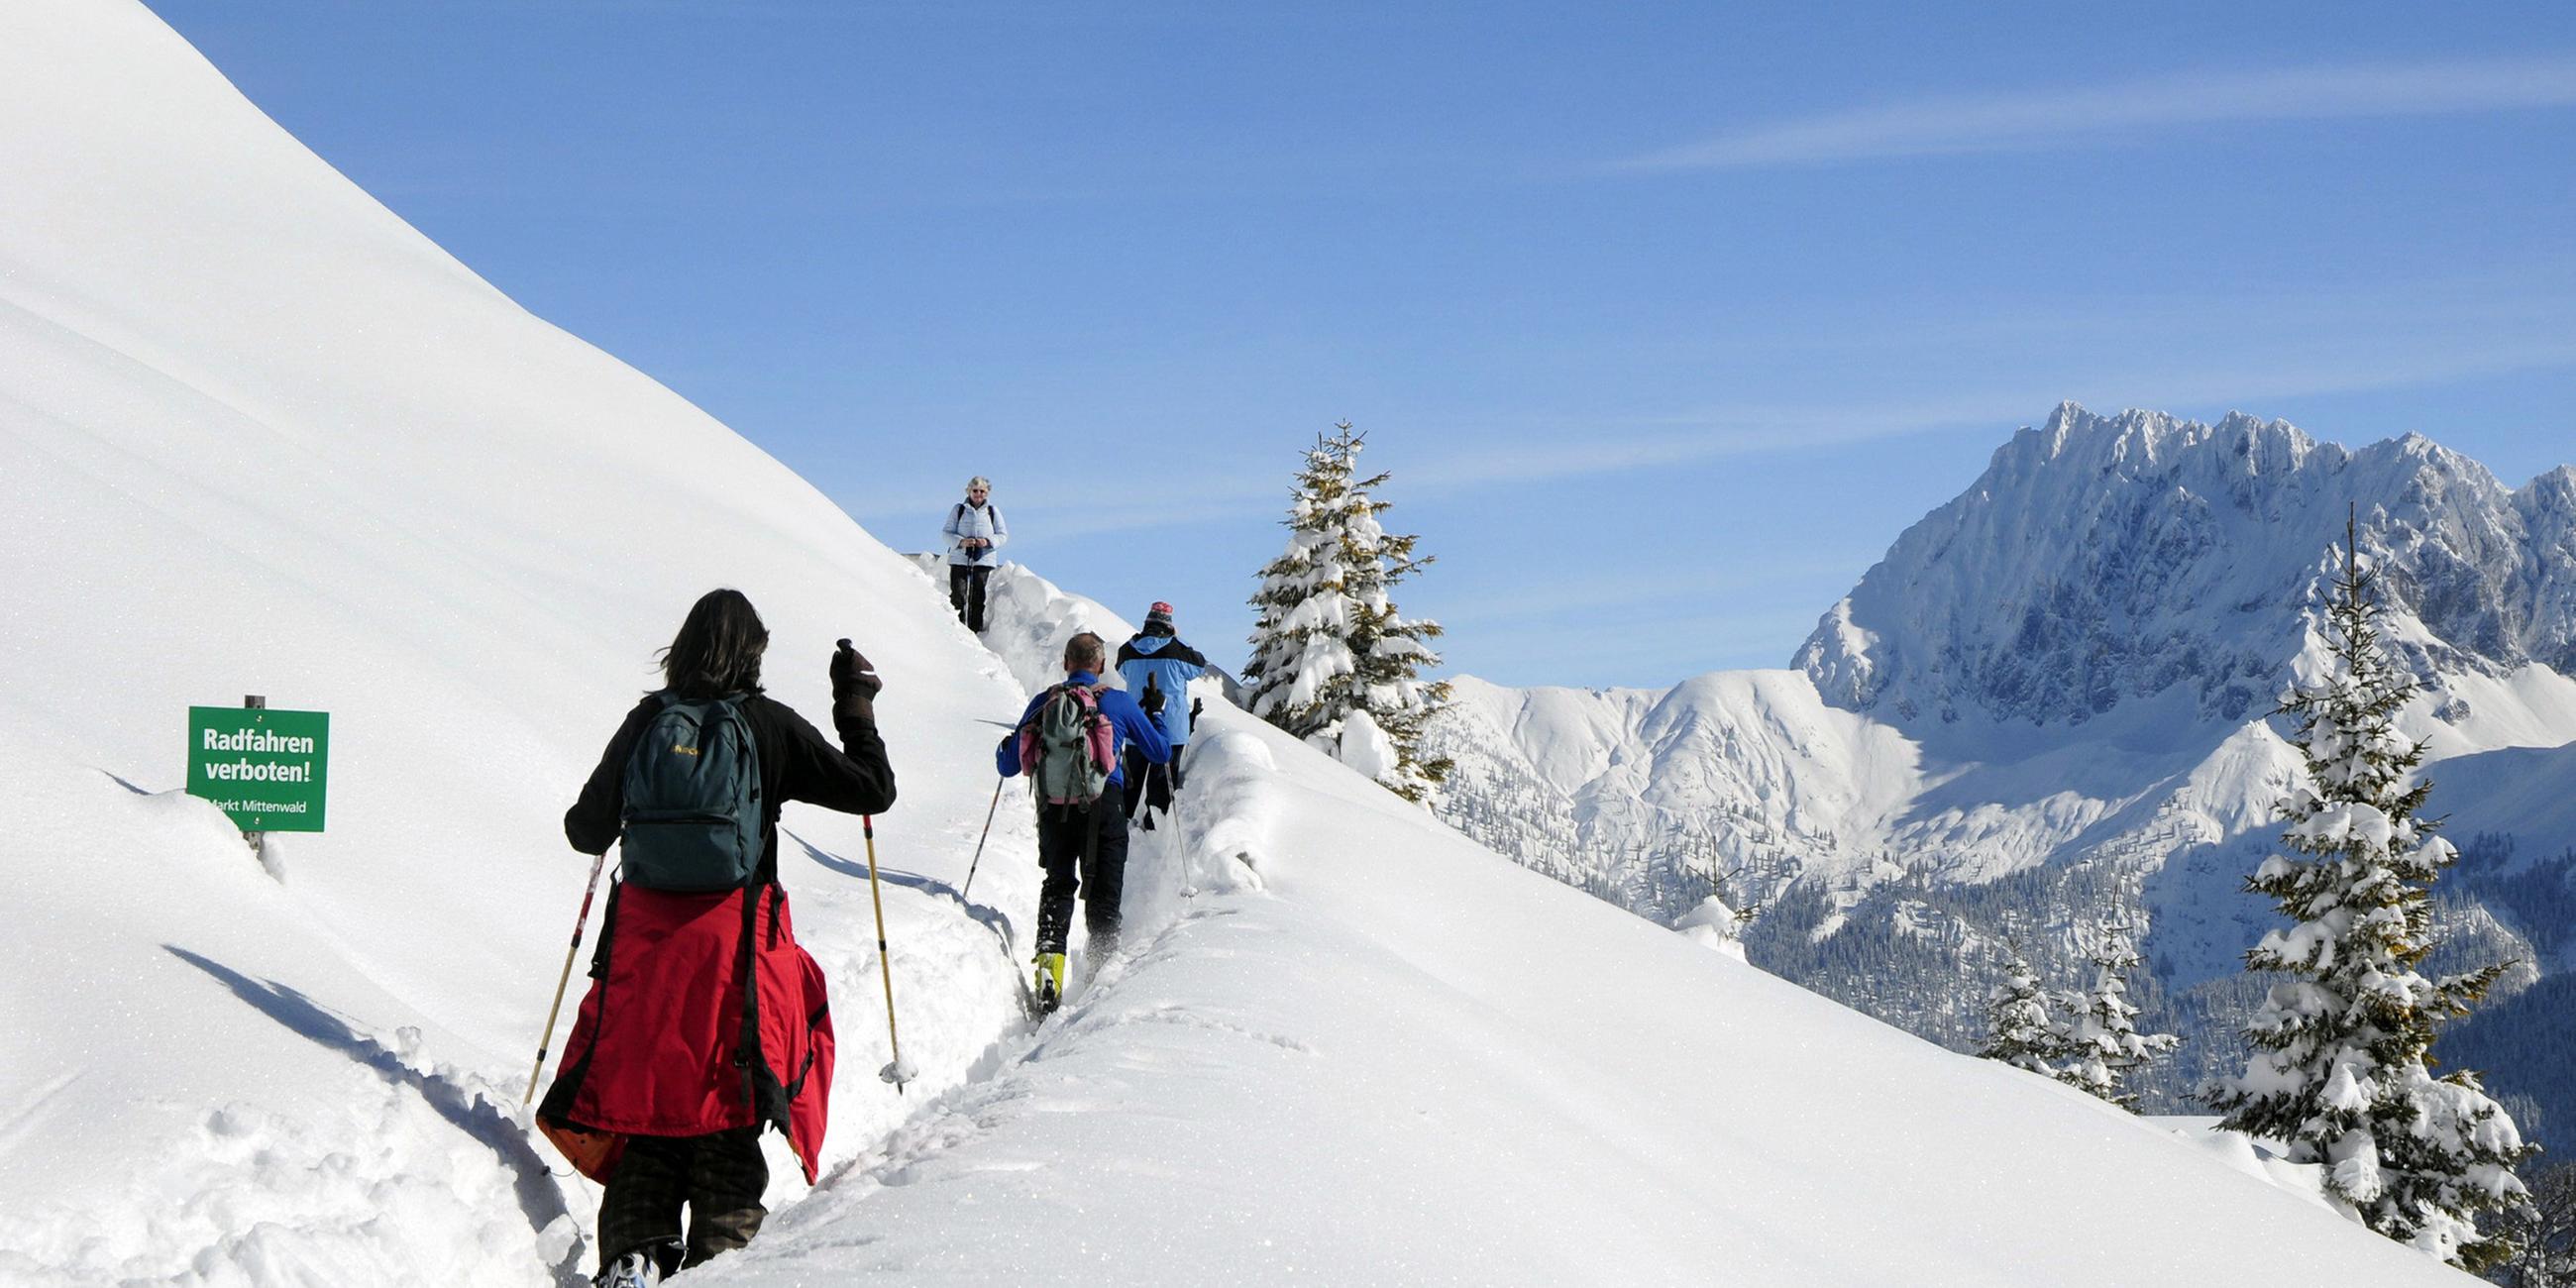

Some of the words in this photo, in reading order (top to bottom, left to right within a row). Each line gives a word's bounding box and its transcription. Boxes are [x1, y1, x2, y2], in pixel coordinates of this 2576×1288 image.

[203, 728, 314, 754] Radfahren
[205, 758, 311, 782] verboten!
[242, 800, 307, 813] Mittenwald
